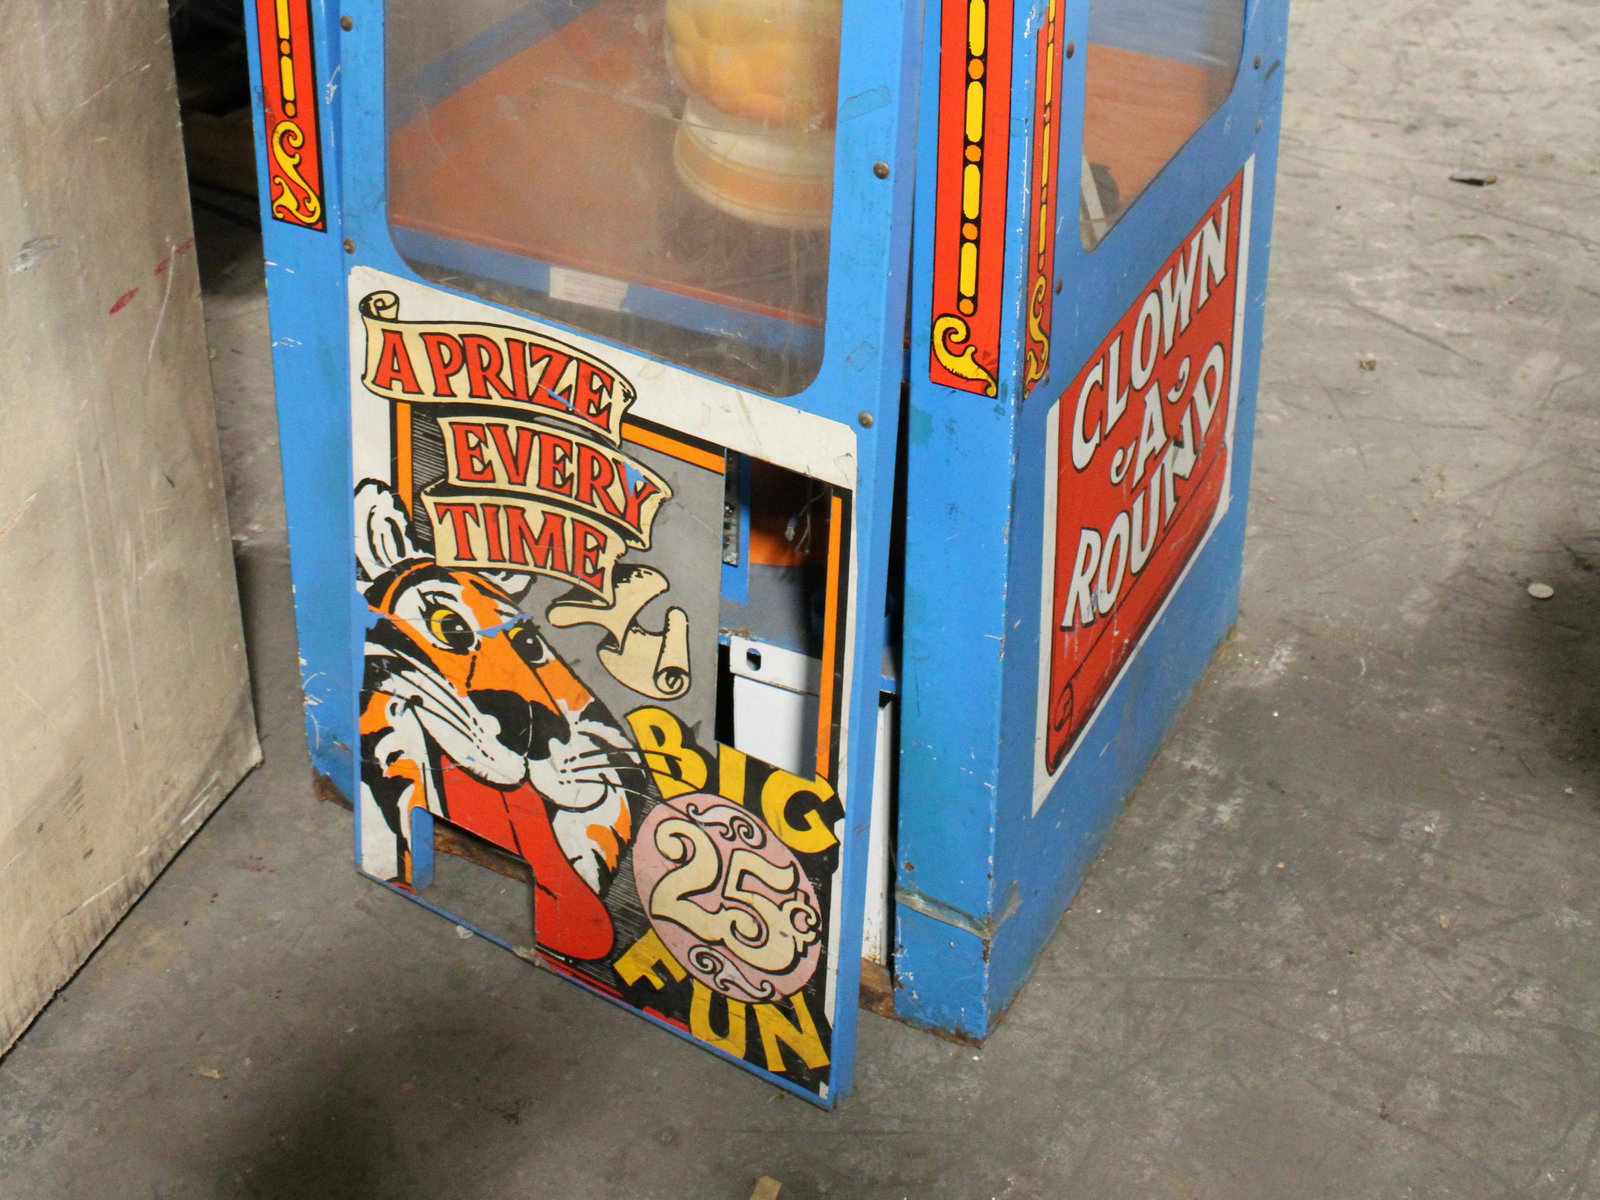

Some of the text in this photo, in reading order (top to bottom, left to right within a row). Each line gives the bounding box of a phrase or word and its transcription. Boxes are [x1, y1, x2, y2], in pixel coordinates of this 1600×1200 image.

[371, 328, 616, 434] A PRIZE
[1071, 191, 1232, 472] CLOWN
[433, 502, 609, 595] TIME
[448, 420, 664, 535] EVERY
[1060, 341, 1225, 632] ROUND
[625, 706, 838, 854] BIG
[613, 928, 831, 1073] FUN
